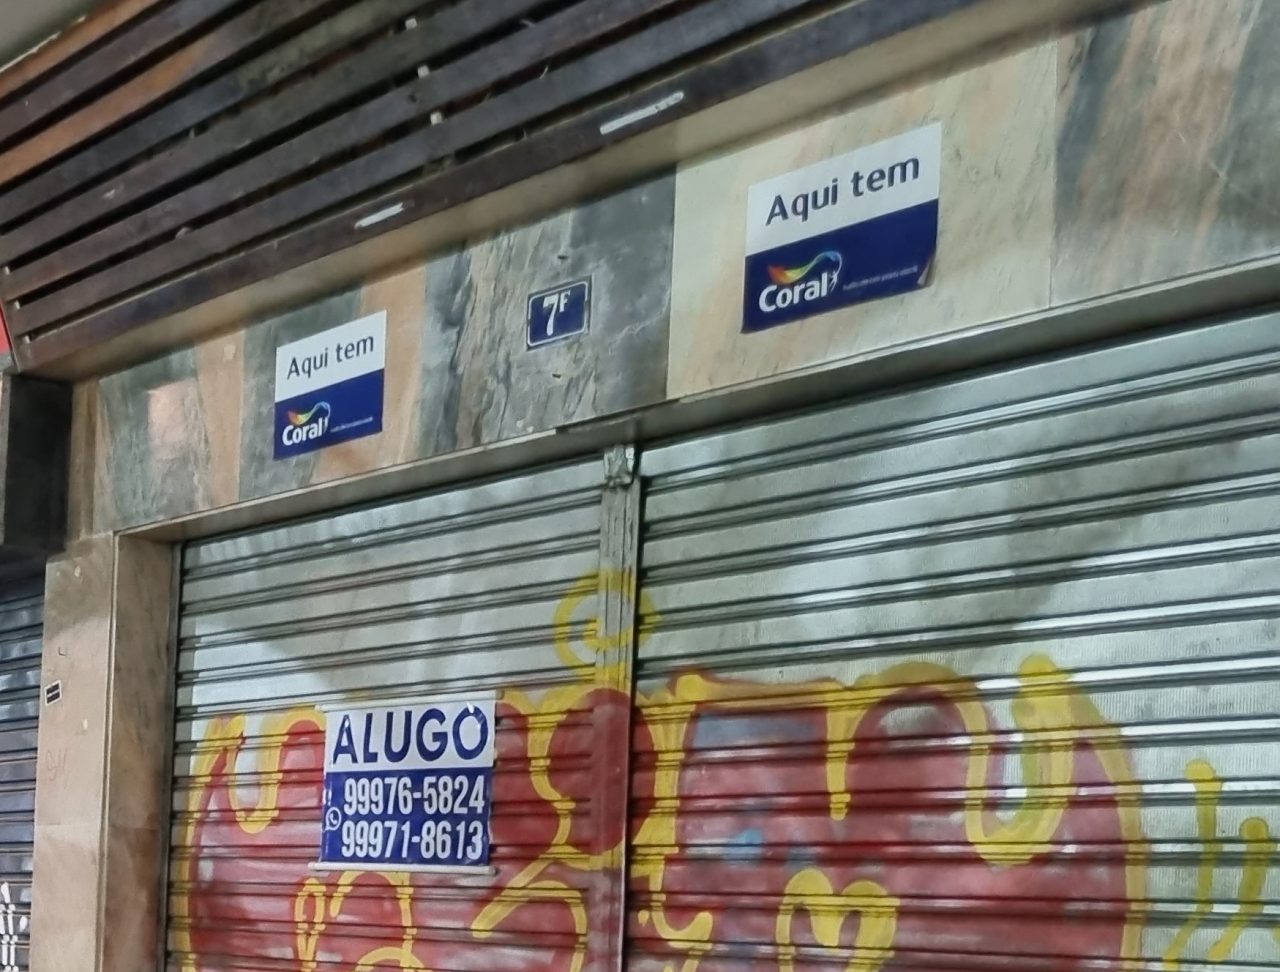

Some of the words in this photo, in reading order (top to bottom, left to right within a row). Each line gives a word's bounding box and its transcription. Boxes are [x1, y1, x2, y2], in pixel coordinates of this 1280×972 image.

[765, 178, 838, 226] Aqui
[851, 157, 919, 197] tem
[758, 272, 828, 313] Coral
[287, 348, 329, 380] Aqui
[336, 335, 374, 363] tem
[282, 417, 323, 446] Coral
[333, 705, 489, 765] ALUGO
[343, 775, 485, 815] 99976-5824
[341, 820, 483, 860] 99971-8613
